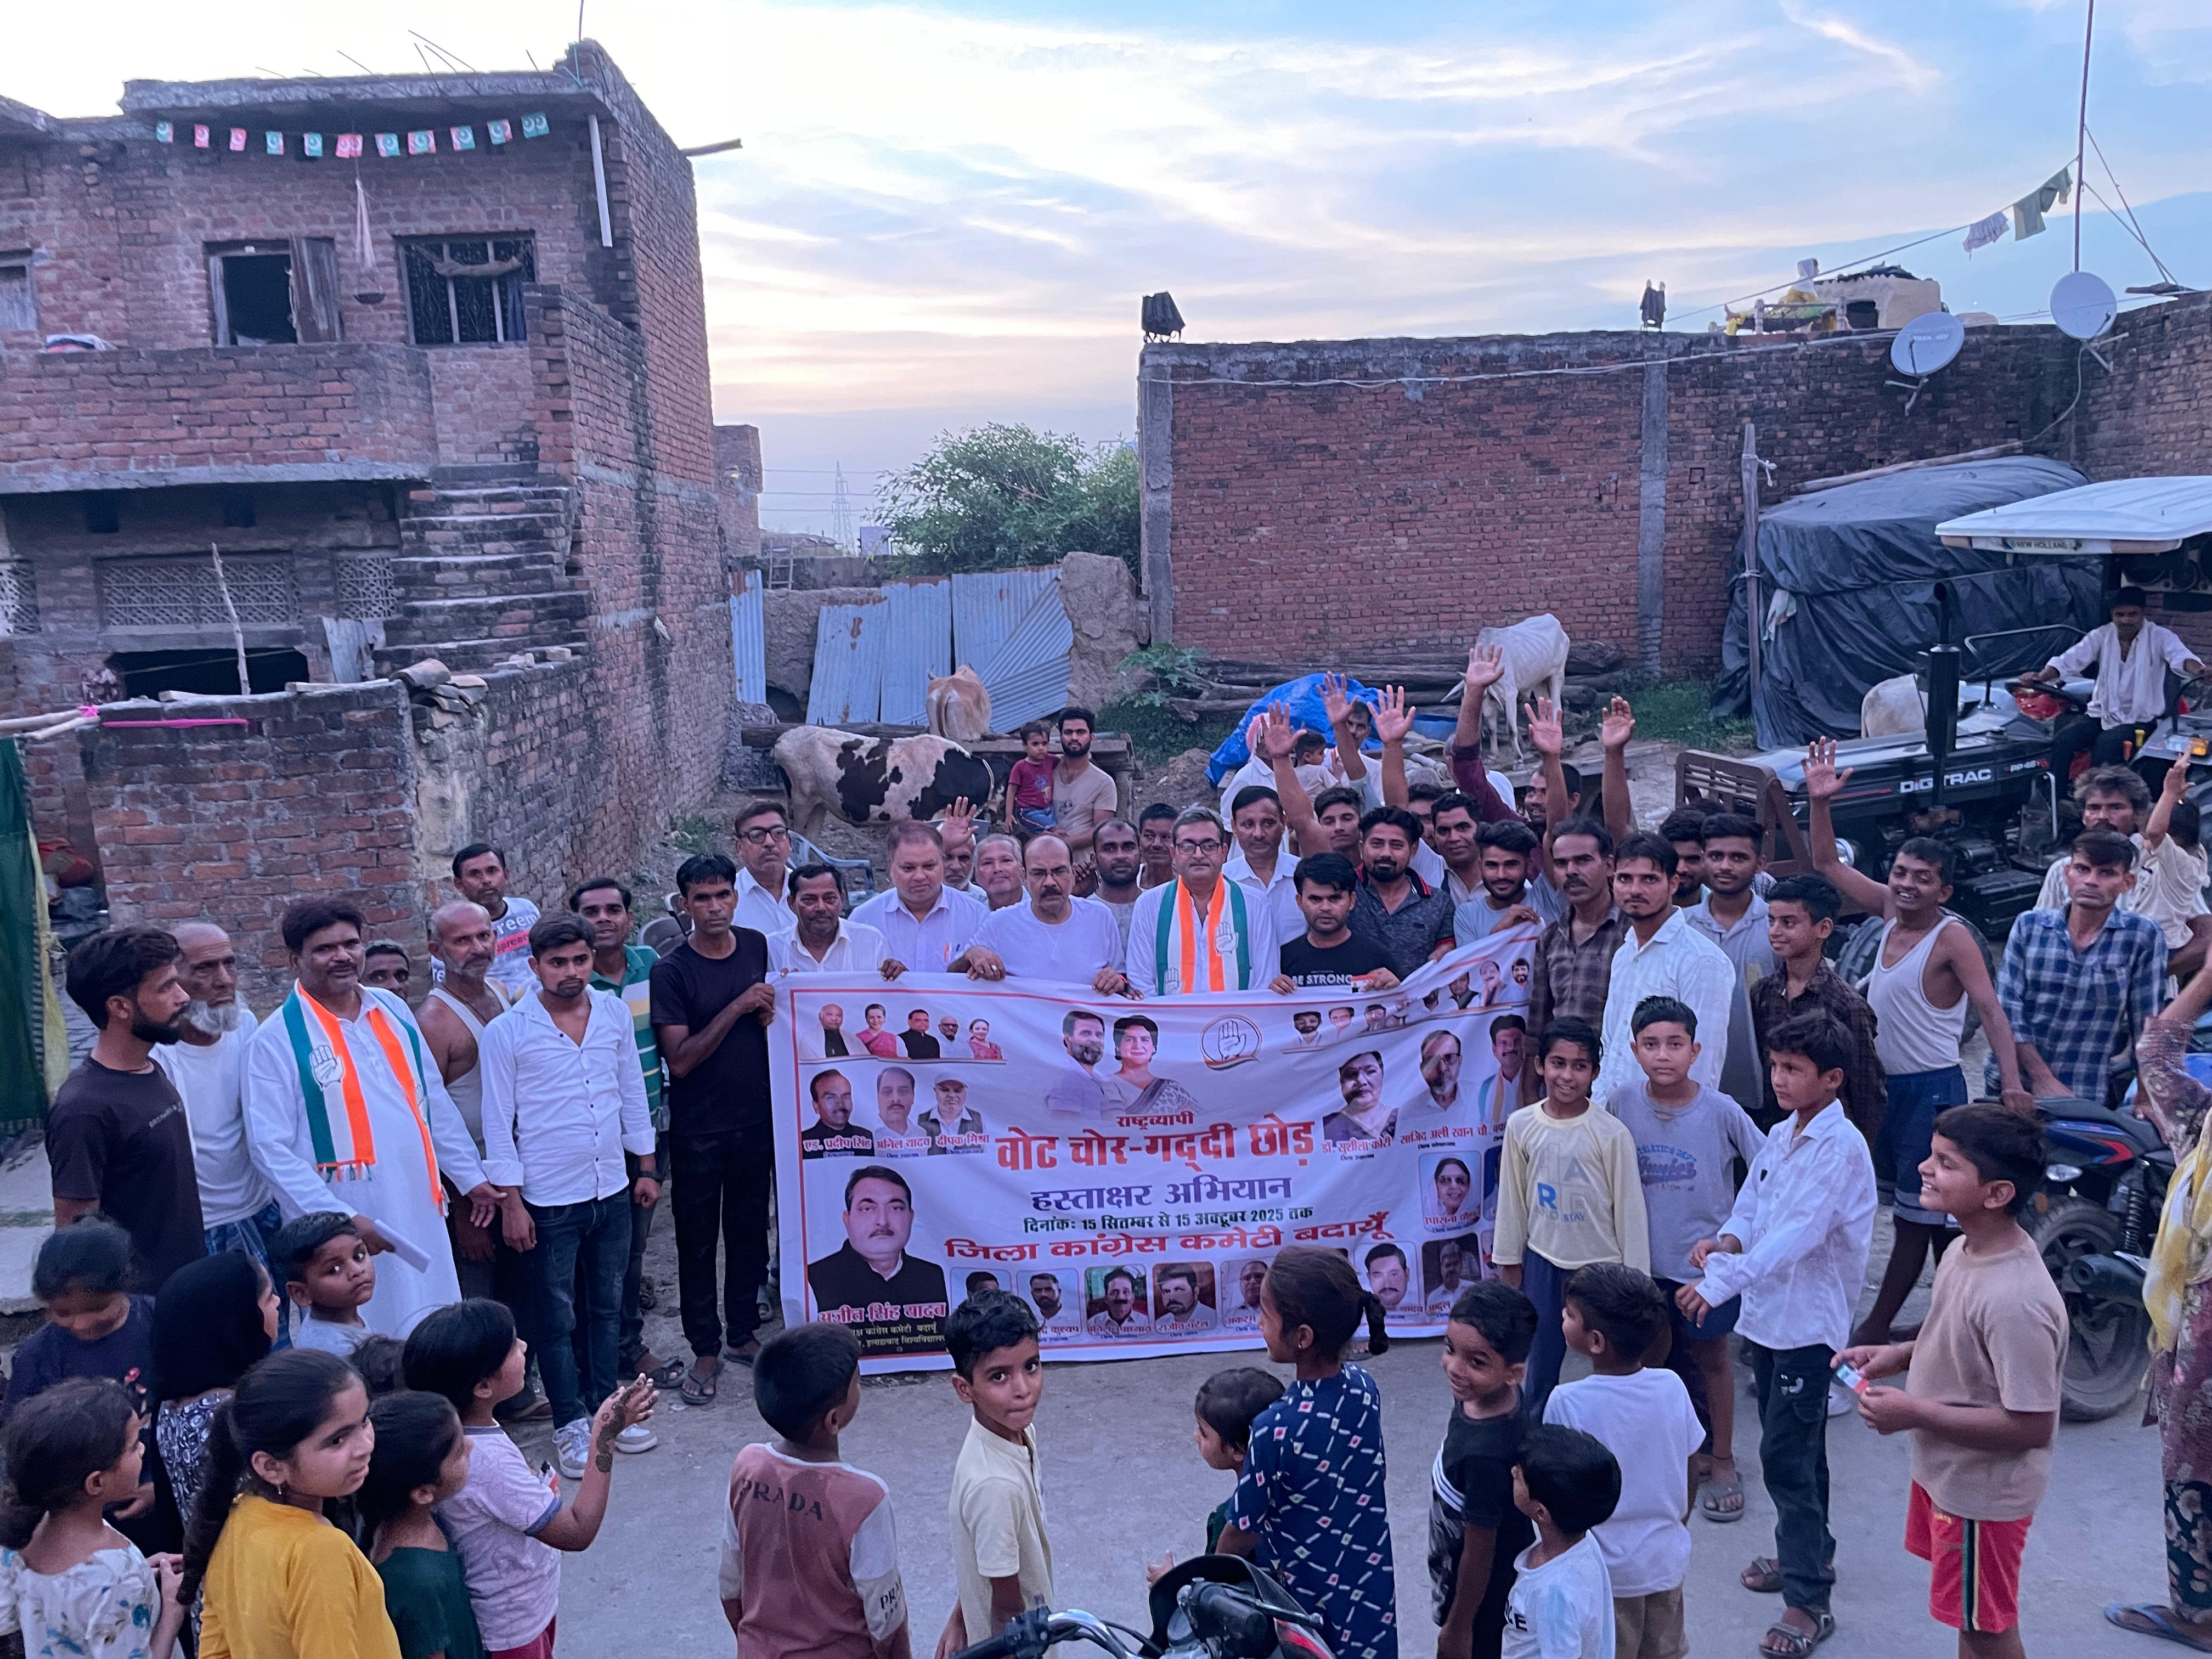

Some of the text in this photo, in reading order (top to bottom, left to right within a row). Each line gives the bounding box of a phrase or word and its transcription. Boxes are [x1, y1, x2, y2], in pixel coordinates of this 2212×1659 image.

[1116, 1111, 1194, 1130] राष्ट्रव्यापी
[936, 1133, 964, 1147] दीपक
[995, 1126, 1059, 1171] वोट
[1248, 1113, 1314, 1166] छोड़
[1430, 1126, 1449, 1139] अली
[1452, 1127, 1474, 1137] खान
[853, 1136, 872, 1149] सिंह
[876, 1137, 930, 1149] अनिल यादव
[1338, 1138, 1369, 1155] सुशीला
[1371, 1135, 1391, 1149] कोरी
[1031, 1174, 1293, 1212] हस्ताक्षर अभियान
[1082, 1220, 1096, 1230] 15
[1101, 1213, 1155, 1230] सितम्बर
[1158, 1211, 1171, 1228] से
[1176, 1214, 1190, 1227] 15
[1251, 1208, 1284, 1223] 2025
[1288, 1206, 1313, 1221] तक
[944, 1238, 1040, 1262] जिला
[1049, 1232, 1167, 1258] कांग्रेस
[1180, 1224, 1285, 1250] कमेटी
[868, 1302, 901, 1321] सिंह
[903, 1302, 946, 1319] यादव
